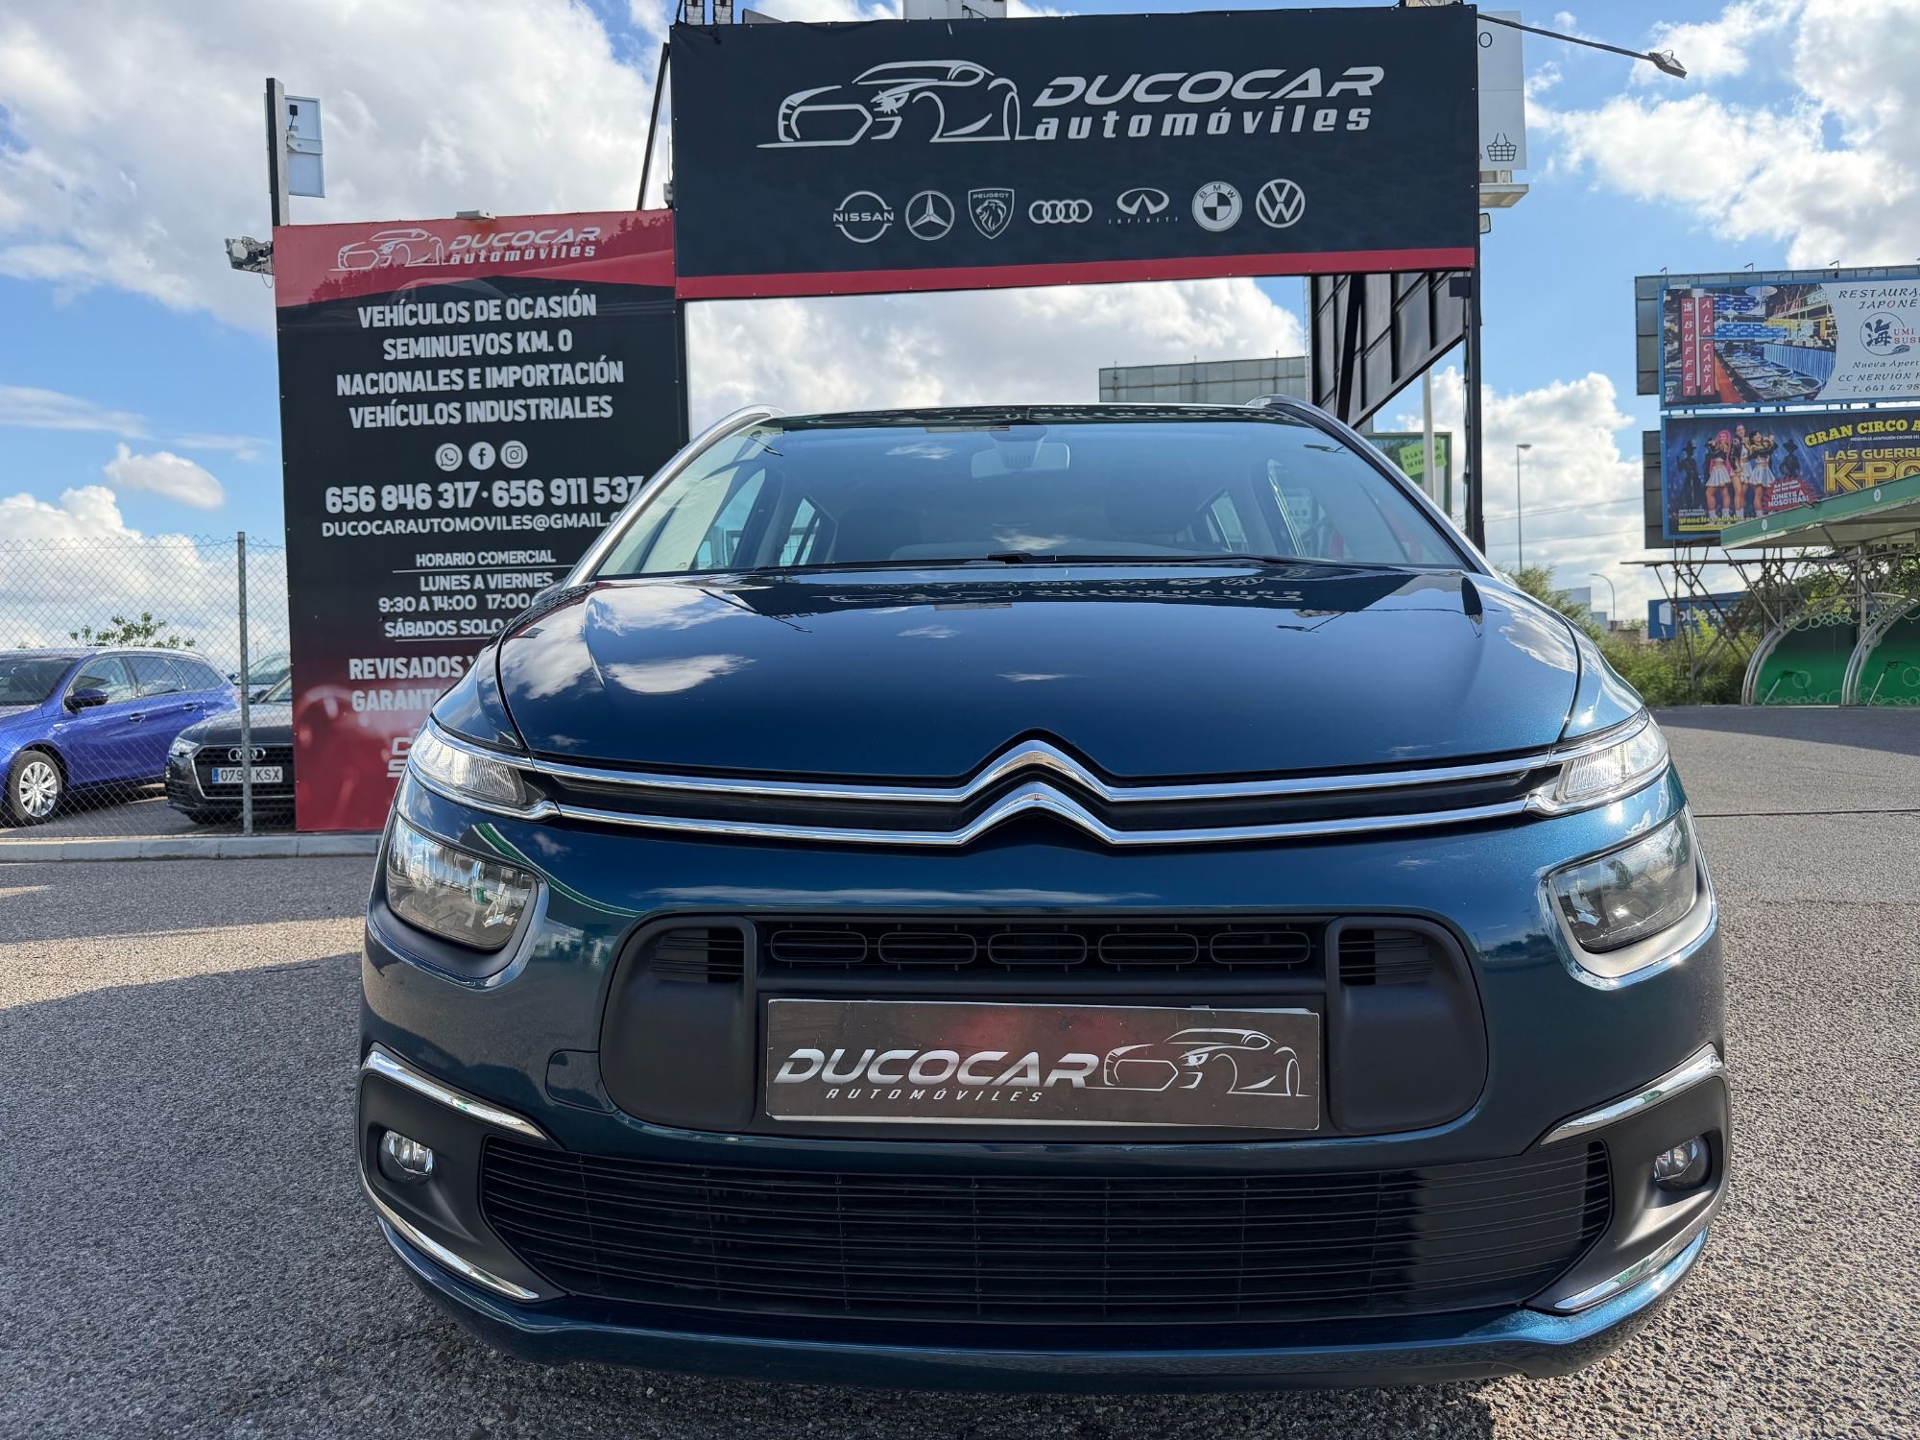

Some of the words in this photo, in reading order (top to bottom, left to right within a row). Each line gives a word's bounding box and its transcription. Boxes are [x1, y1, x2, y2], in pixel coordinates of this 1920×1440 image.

[1032, 66, 1385, 107] DUCOCAR
[1035, 105, 1372, 140] automóviles
[1198, 184, 1237, 200] BMW
[832, 211, 895, 222] NISSAN
[449, 227, 600, 250] DUCOCAR
[1838, 287, 1920, 299] RESTAURA
[1858, 298, 1920, 309] JAPONE
[357, 299, 471, 328] VEHÍCULOS
[474, 300, 502, 322] DE
[505, 288, 598, 321] OCASIÓN
[1893, 328, 1914, 336] UMI
[383, 332, 514, 361] SEMINUEVOS
[516, 331, 554, 353] KM.
[1682, 321, 1694, 395] BUFFET
[1702, 343, 1713, 393] CARTA
[336, 368, 465, 396] NACIONALES
[468, 367, 482, 390] E
[485, 355, 625, 388] IMPORTACIÓN
[1838, 374, 1854, 382] CC
[348, 399, 463, 429] VEHÍCULOS
[465, 395, 614, 423] INDUSTRIALES
[1804, 424, 1853, 447] GRAN
[1856, 419, 1909, 435] CIRCO
[1824, 449, 1858, 461] LAS
[324, 485, 376, 514] 656
[380, 483, 433, 512] 846
[549, 477, 589, 506] 911
[592, 475, 645, 504] 537
[415, 551, 475, 567] HORARIO
[477, 549, 557, 565] COMERCIAL
[419, 574, 471, 591] LUNES
[473, 573, 486, 590] A
[486, 571, 554, 589] VIERNES
[378, 596, 417, 613] 9:30
[418, 596, 431, 612] A
[431, 594, 477, 611] 14:00
[485, 592, 530, 610] 17:00
[384, 617, 458, 638] SÁBADOS
[459, 618, 504, 636] SOLO
[348, 655, 464, 680] REVISADOS
[221, 769, 244, 782] 079
[255, 768, 280, 781] KSX
[773, 1047, 1099, 1088] DUCOCAR
[825, 1086, 1044, 1102] AUTOMÓVILES
